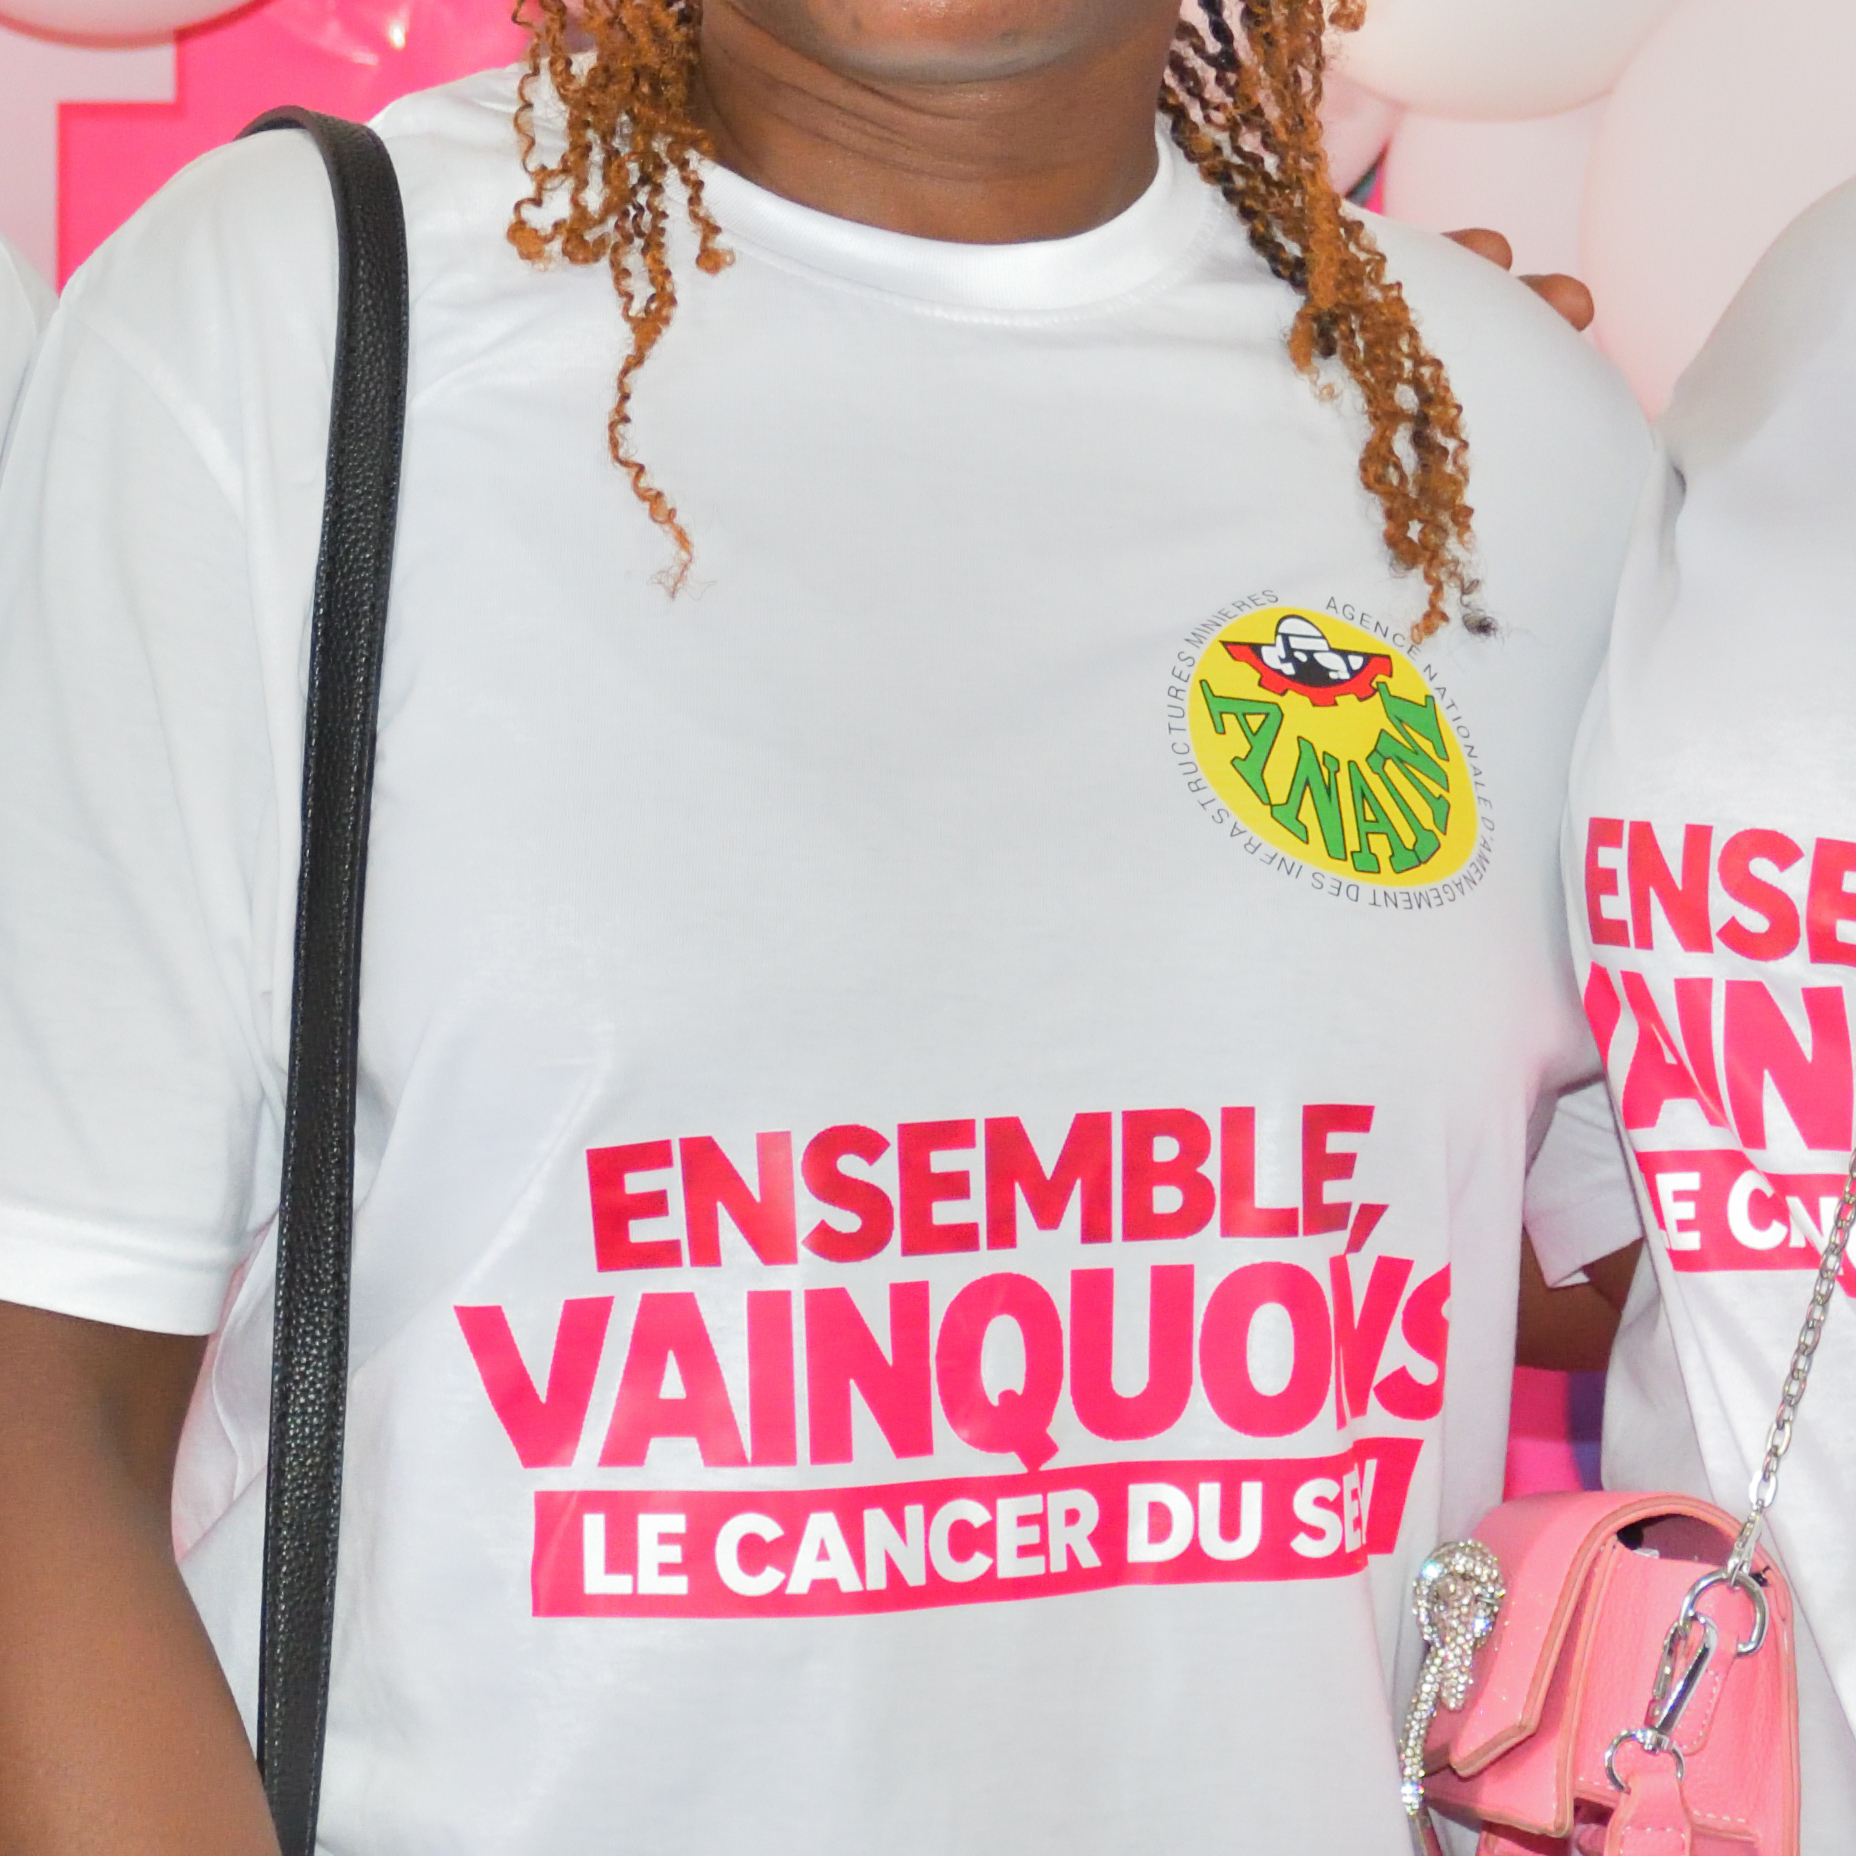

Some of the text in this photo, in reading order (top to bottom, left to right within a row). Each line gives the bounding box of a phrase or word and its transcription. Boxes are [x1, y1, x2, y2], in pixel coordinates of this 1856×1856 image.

[1167, 589, 1495, 910] AGENCE NATIONALE D'AMENAGEMENT DES INFRASTRUCTURES MINIERES
[1199, 679, 1450, 874] ANAIM
[585, 1104, 1389, 1272] ENSEMBLE,
[1655, 1172, 1701, 1251] E
[582, 1513, 688, 1595] LE
[715, 1490, 1104, 1597] CANCER
[1128, 1480, 1272, 1562] DU
